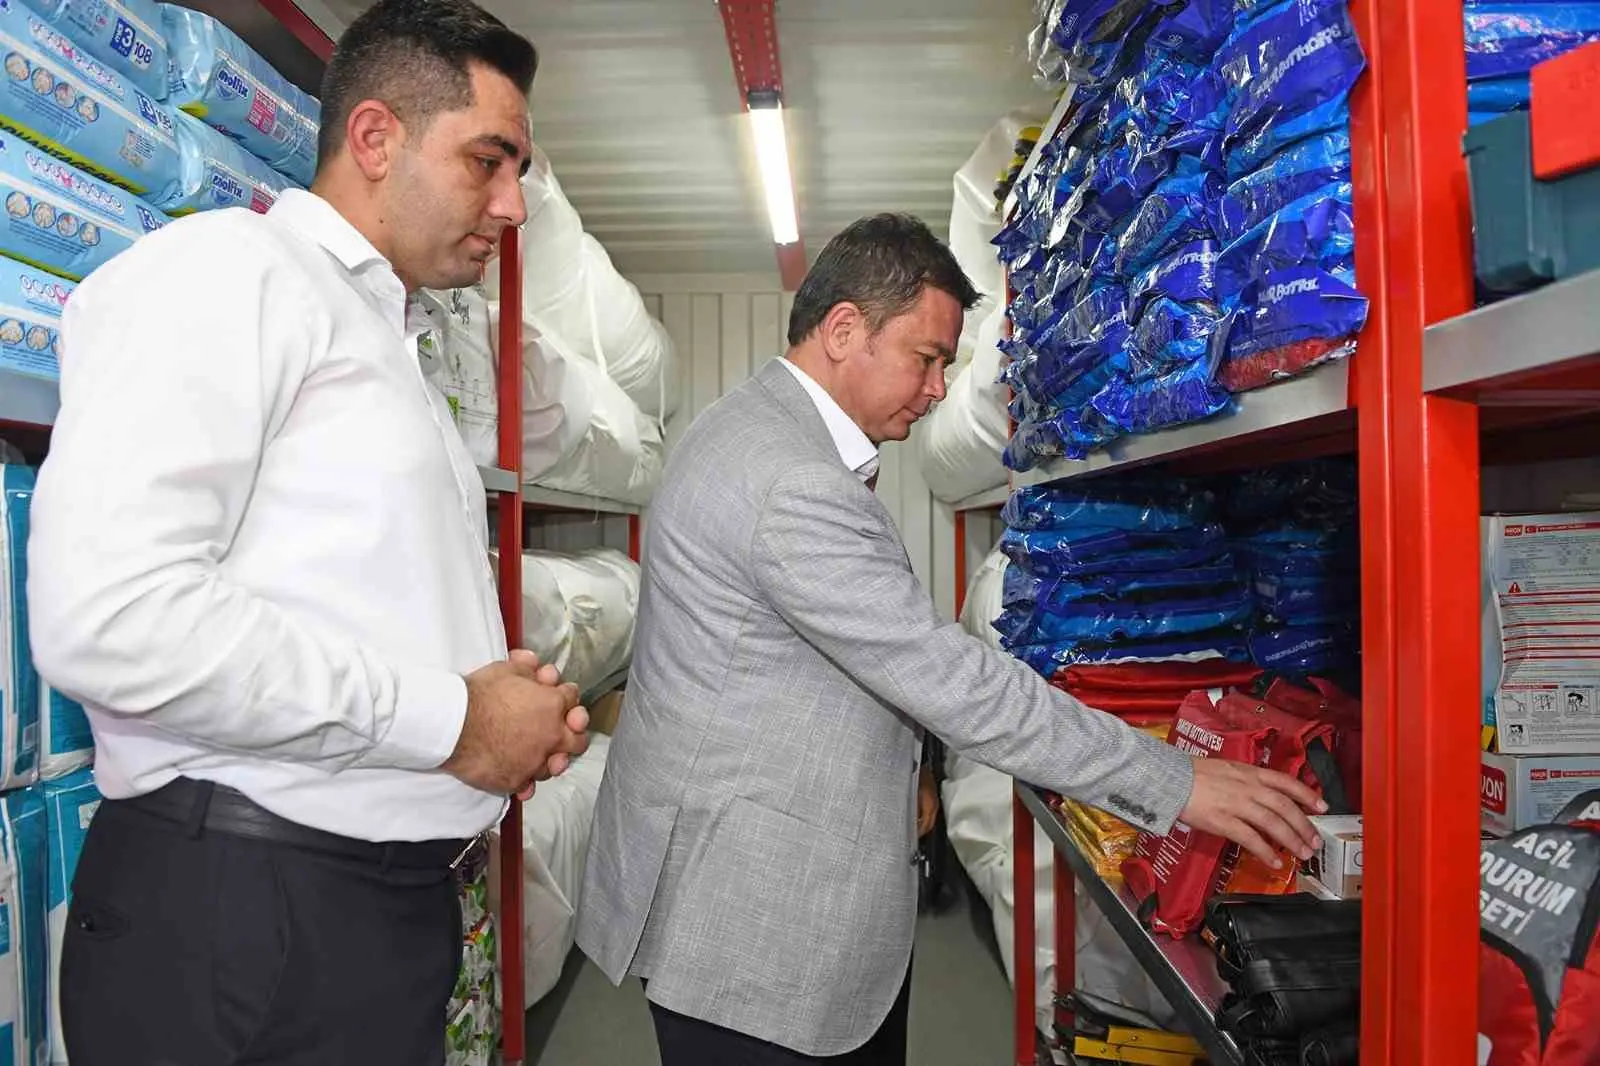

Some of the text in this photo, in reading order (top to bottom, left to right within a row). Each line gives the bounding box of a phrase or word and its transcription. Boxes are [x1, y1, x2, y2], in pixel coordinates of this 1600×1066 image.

[121, 27, 134, 48] 3
[134, 42, 152, 63] 108
[218, 69, 249, 98] molfix
[1512, 832, 1577, 869] ACİL
